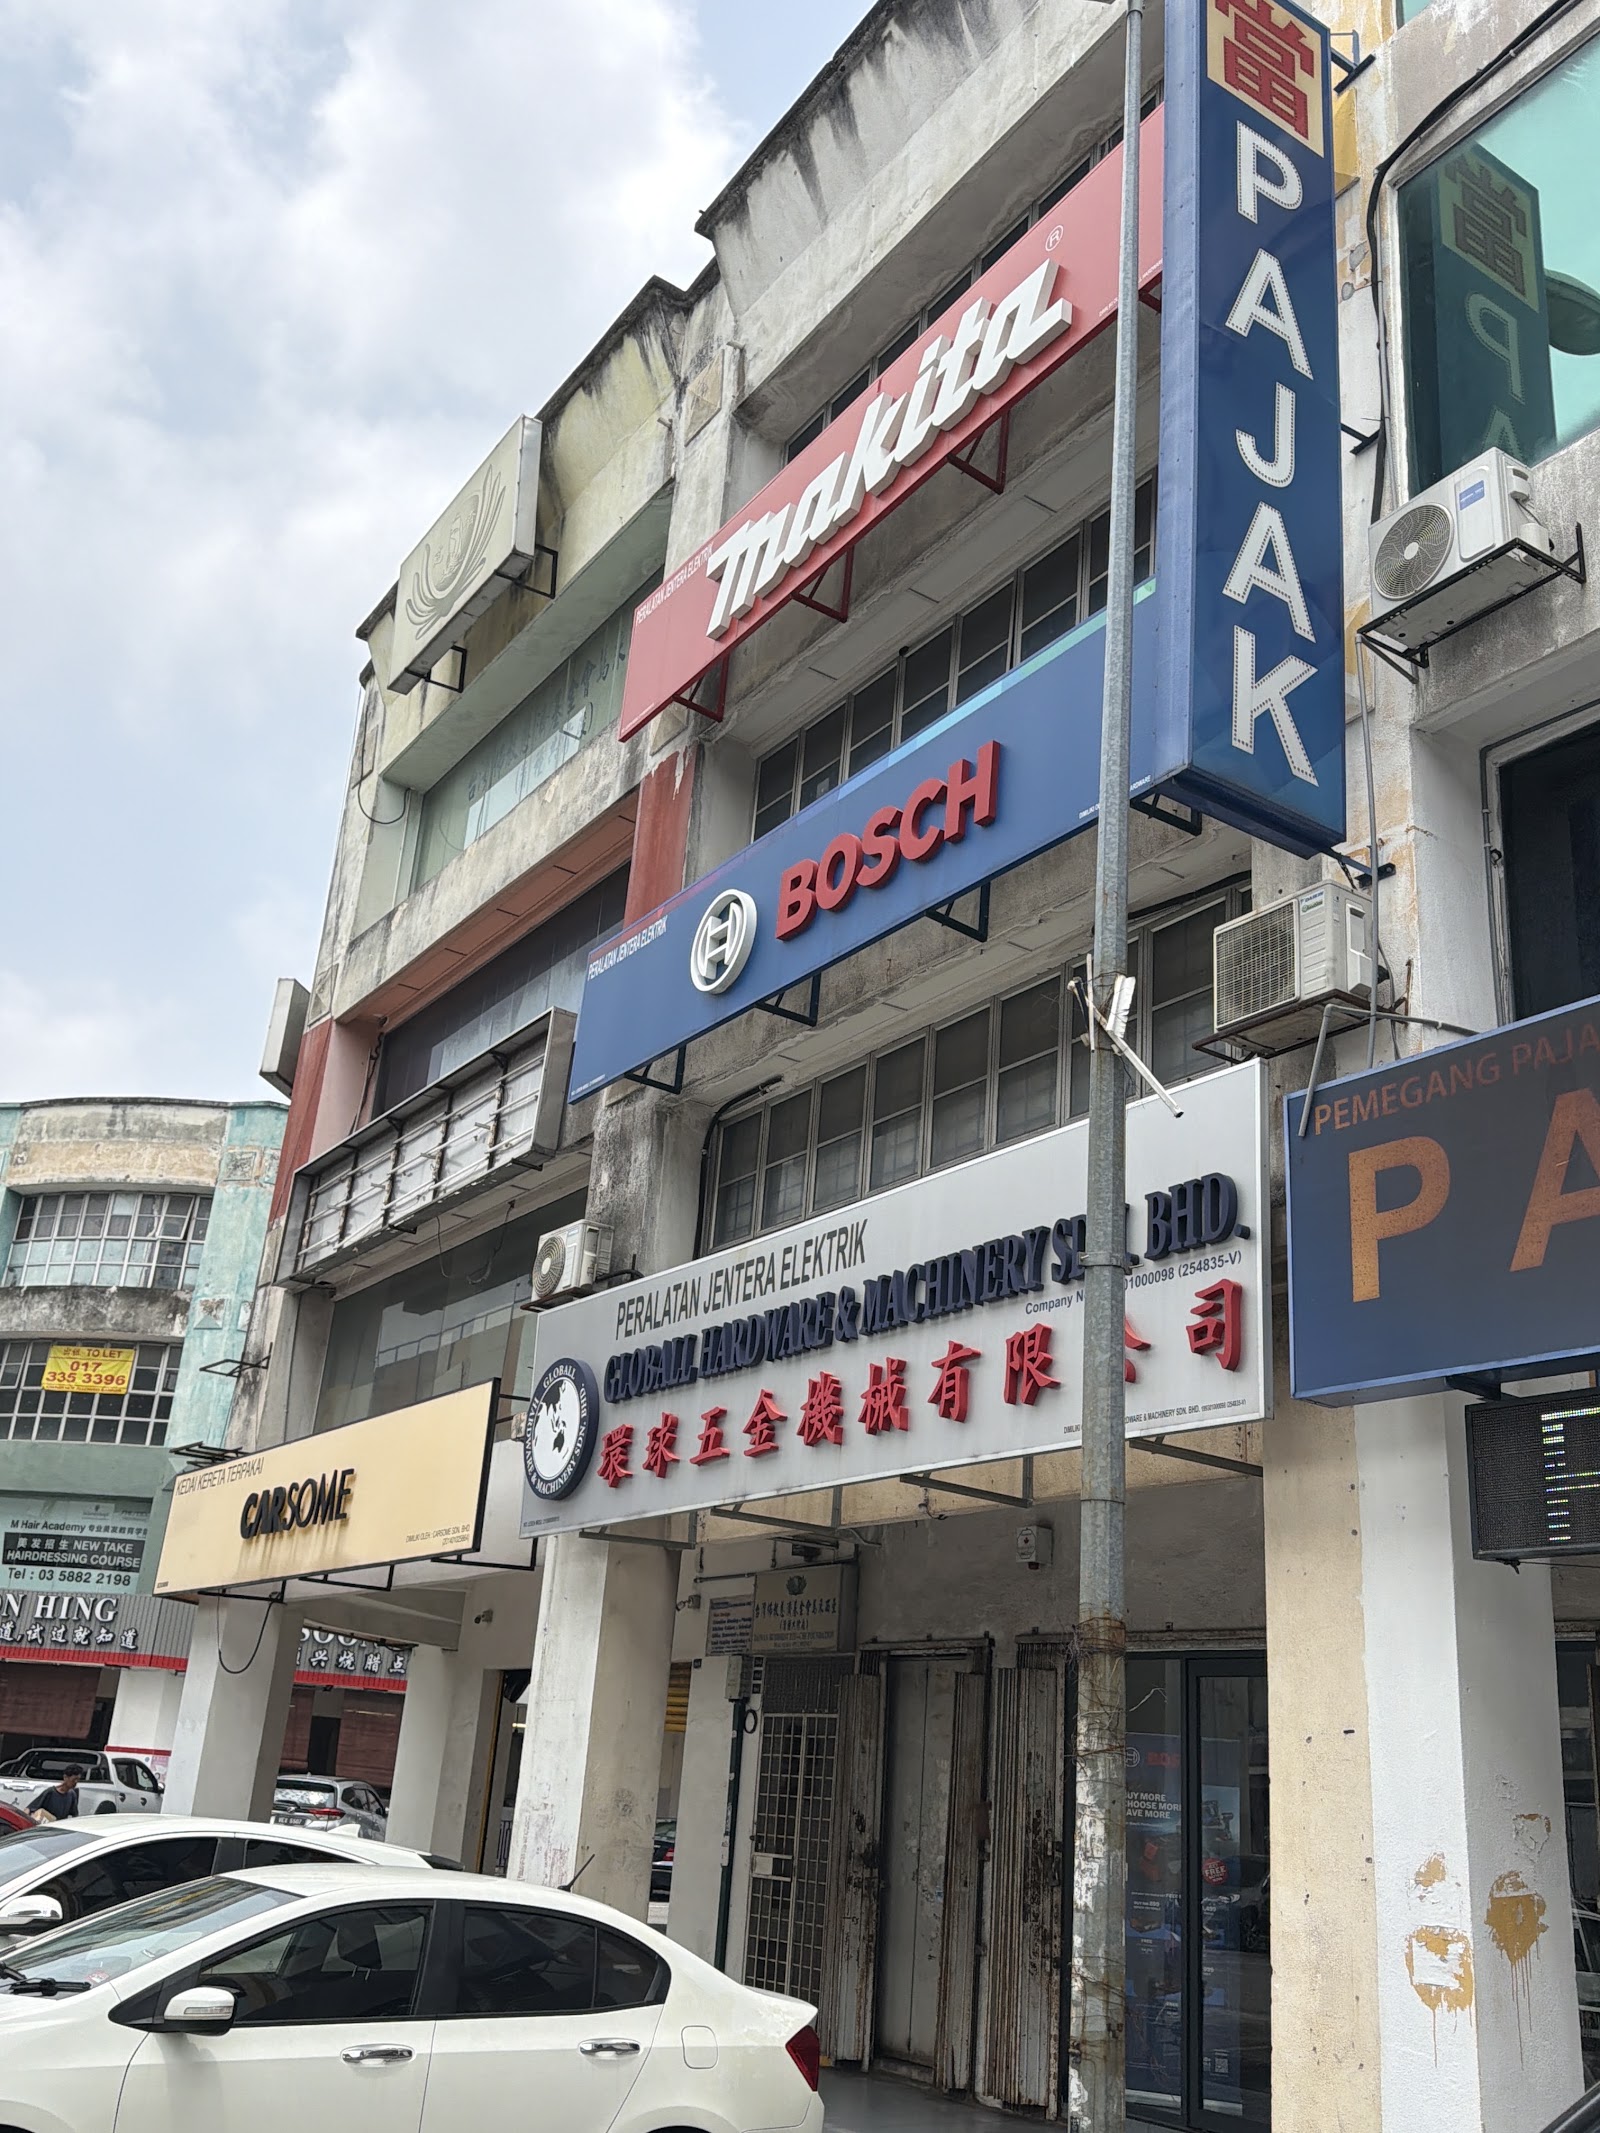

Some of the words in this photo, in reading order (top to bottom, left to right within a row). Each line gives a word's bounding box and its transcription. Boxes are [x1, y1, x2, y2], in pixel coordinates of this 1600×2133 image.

[705, 257, 1074, 641] makita
[1222, 120, 1320, 788] PAJAK
[775, 739, 1001, 941] BOSCH
[587, 948, 618, 981] PERALATAN
[617, 933, 641, 963] JENTERA
[640, 914, 668, 948] ELEKTRIK
[1314, 1052, 1502, 1136] PEMEGANG
[604, 1333, 698, 1404] GLOBALL
[700, 1291, 837, 1379] HARDWARE
[836, 1285, 859, 1342] &
[860, 1226, 1050, 1336] MACHINERY
[1145, 1172, 1250, 1262] BHD.
[615, 1276, 701, 1340] PERALATAN
[703, 1252, 776, 1315] JENTERA
[779, 1218, 869, 1290] ELEKTRIK
[1025, 1293, 1073, 1315] Company
[1124, 1267, 1175, 1291] 1000098
[1178, 1250, 1242, 1278] (254835-V)
[70, 1361, 102, 1372] 017
[86, 1348, 100, 1357] TO
[103, 1349, 123, 1358] LET
[45, 1371, 77, 1383] 335
[81, 1373, 126, 1386] 3396
[542, 1365, 576, 1389] GLOBALL
[525, 1397, 540, 1472] HARDWARE
[176, 1475, 199, 1496] KEDAI
[199, 1468, 226, 1490] KERETA
[227, 1456, 265, 1483] TERPAKAI
[536, 1457, 577, 1496] MACHINERY
[240, 1468, 355, 1539] CARSOME
[10, 1520, 19, 1528] M
[21, 1520, 42, 1529] Hair
[41, 1520, 86, 1533] Academy
[6, 1550, 87, 1564] HAIRDRESSING
[90, 1555, 140, 1568] COURSE
[73, 1540, 101, 1551] NEW
[103, 1541, 134, 1554] TAKE
[38, 1569, 54, 1581] 03
[58, 1571, 92, 1583] 5882
[96, 1573, 131, 1586] 2198
[34, 1594, 119, 1622] HING
[1126, 1791, 1139, 1800] UY
[1140, 1793, 1166, 1802] MORE
[1126, 1800, 1158, 1810] HOOSE
[1126, 1809, 1143, 1817] AVE
[1144, 1810, 1171, 1819] MORE
